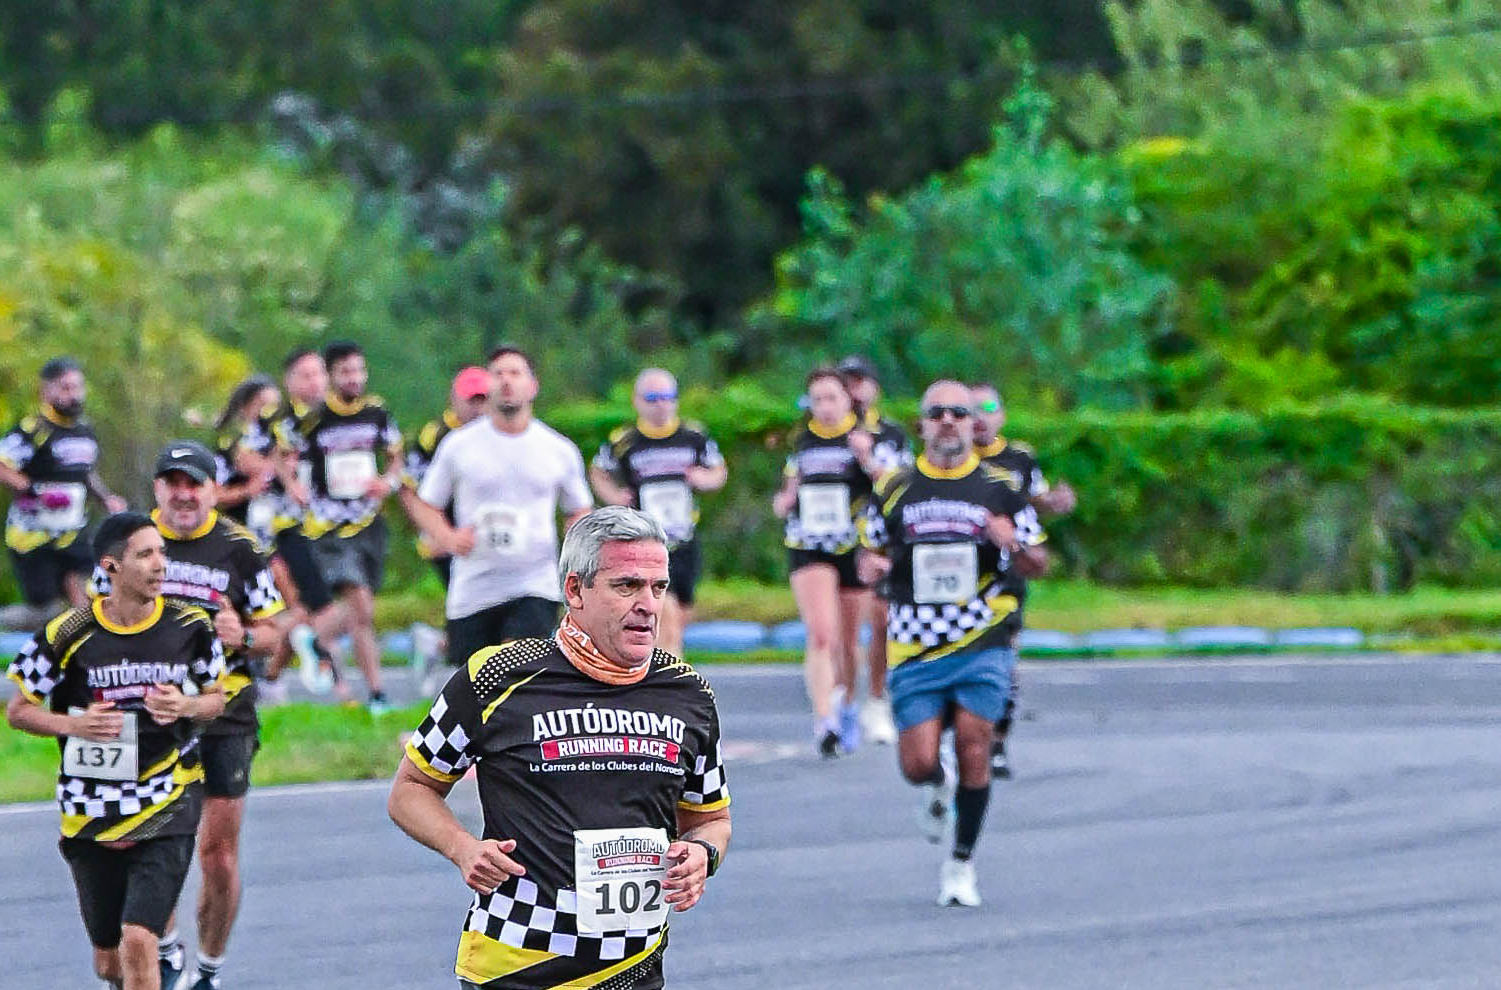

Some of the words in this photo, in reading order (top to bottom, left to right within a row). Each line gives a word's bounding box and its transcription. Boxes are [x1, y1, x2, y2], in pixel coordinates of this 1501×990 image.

[532, 702, 686, 744] AUTÓDROMO
[76, 746, 123, 768] 137
[557, 738, 624, 757] RUNNING
[628, 738, 667, 758] RACE
[529, 762, 540, 772] La
[542, 762, 577, 772] Carrera
[578, 761, 590, 772] de
[592, 761, 605, 772] los
[607, 761, 638, 772] Clubes
[639, 763, 654, 773] del
[595, 880, 661, 915] 102
